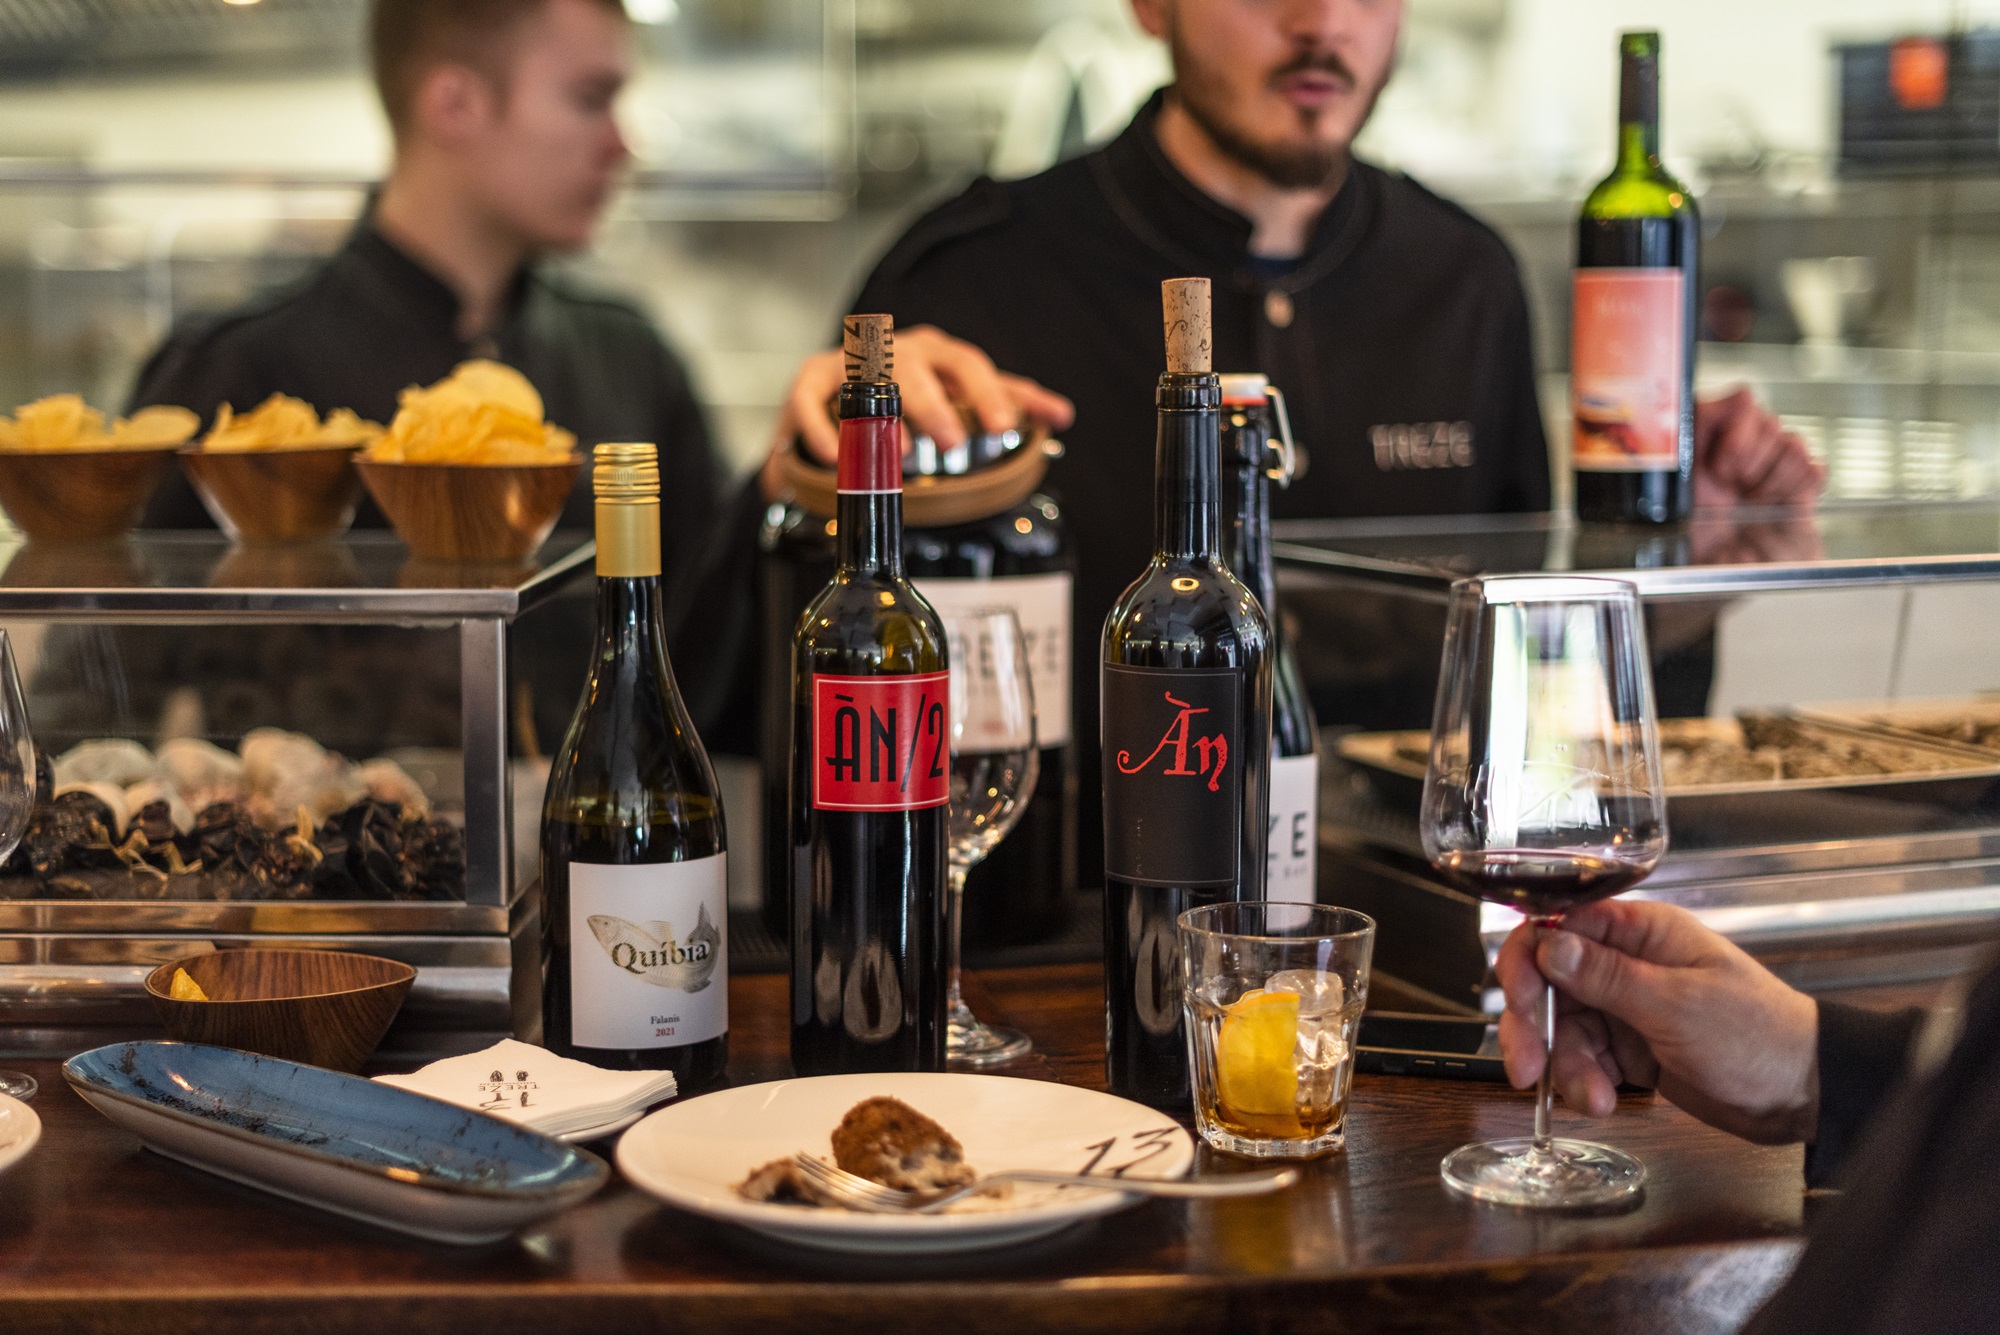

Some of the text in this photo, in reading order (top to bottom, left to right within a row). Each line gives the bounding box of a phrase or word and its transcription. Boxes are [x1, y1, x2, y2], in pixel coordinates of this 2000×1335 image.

[650, 1014, 681, 1025] Falanis
[655, 1027, 675, 1037] 2021
[478, 1084, 541, 1093] TREZE
[1078, 1126, 1181, 1179] 13
